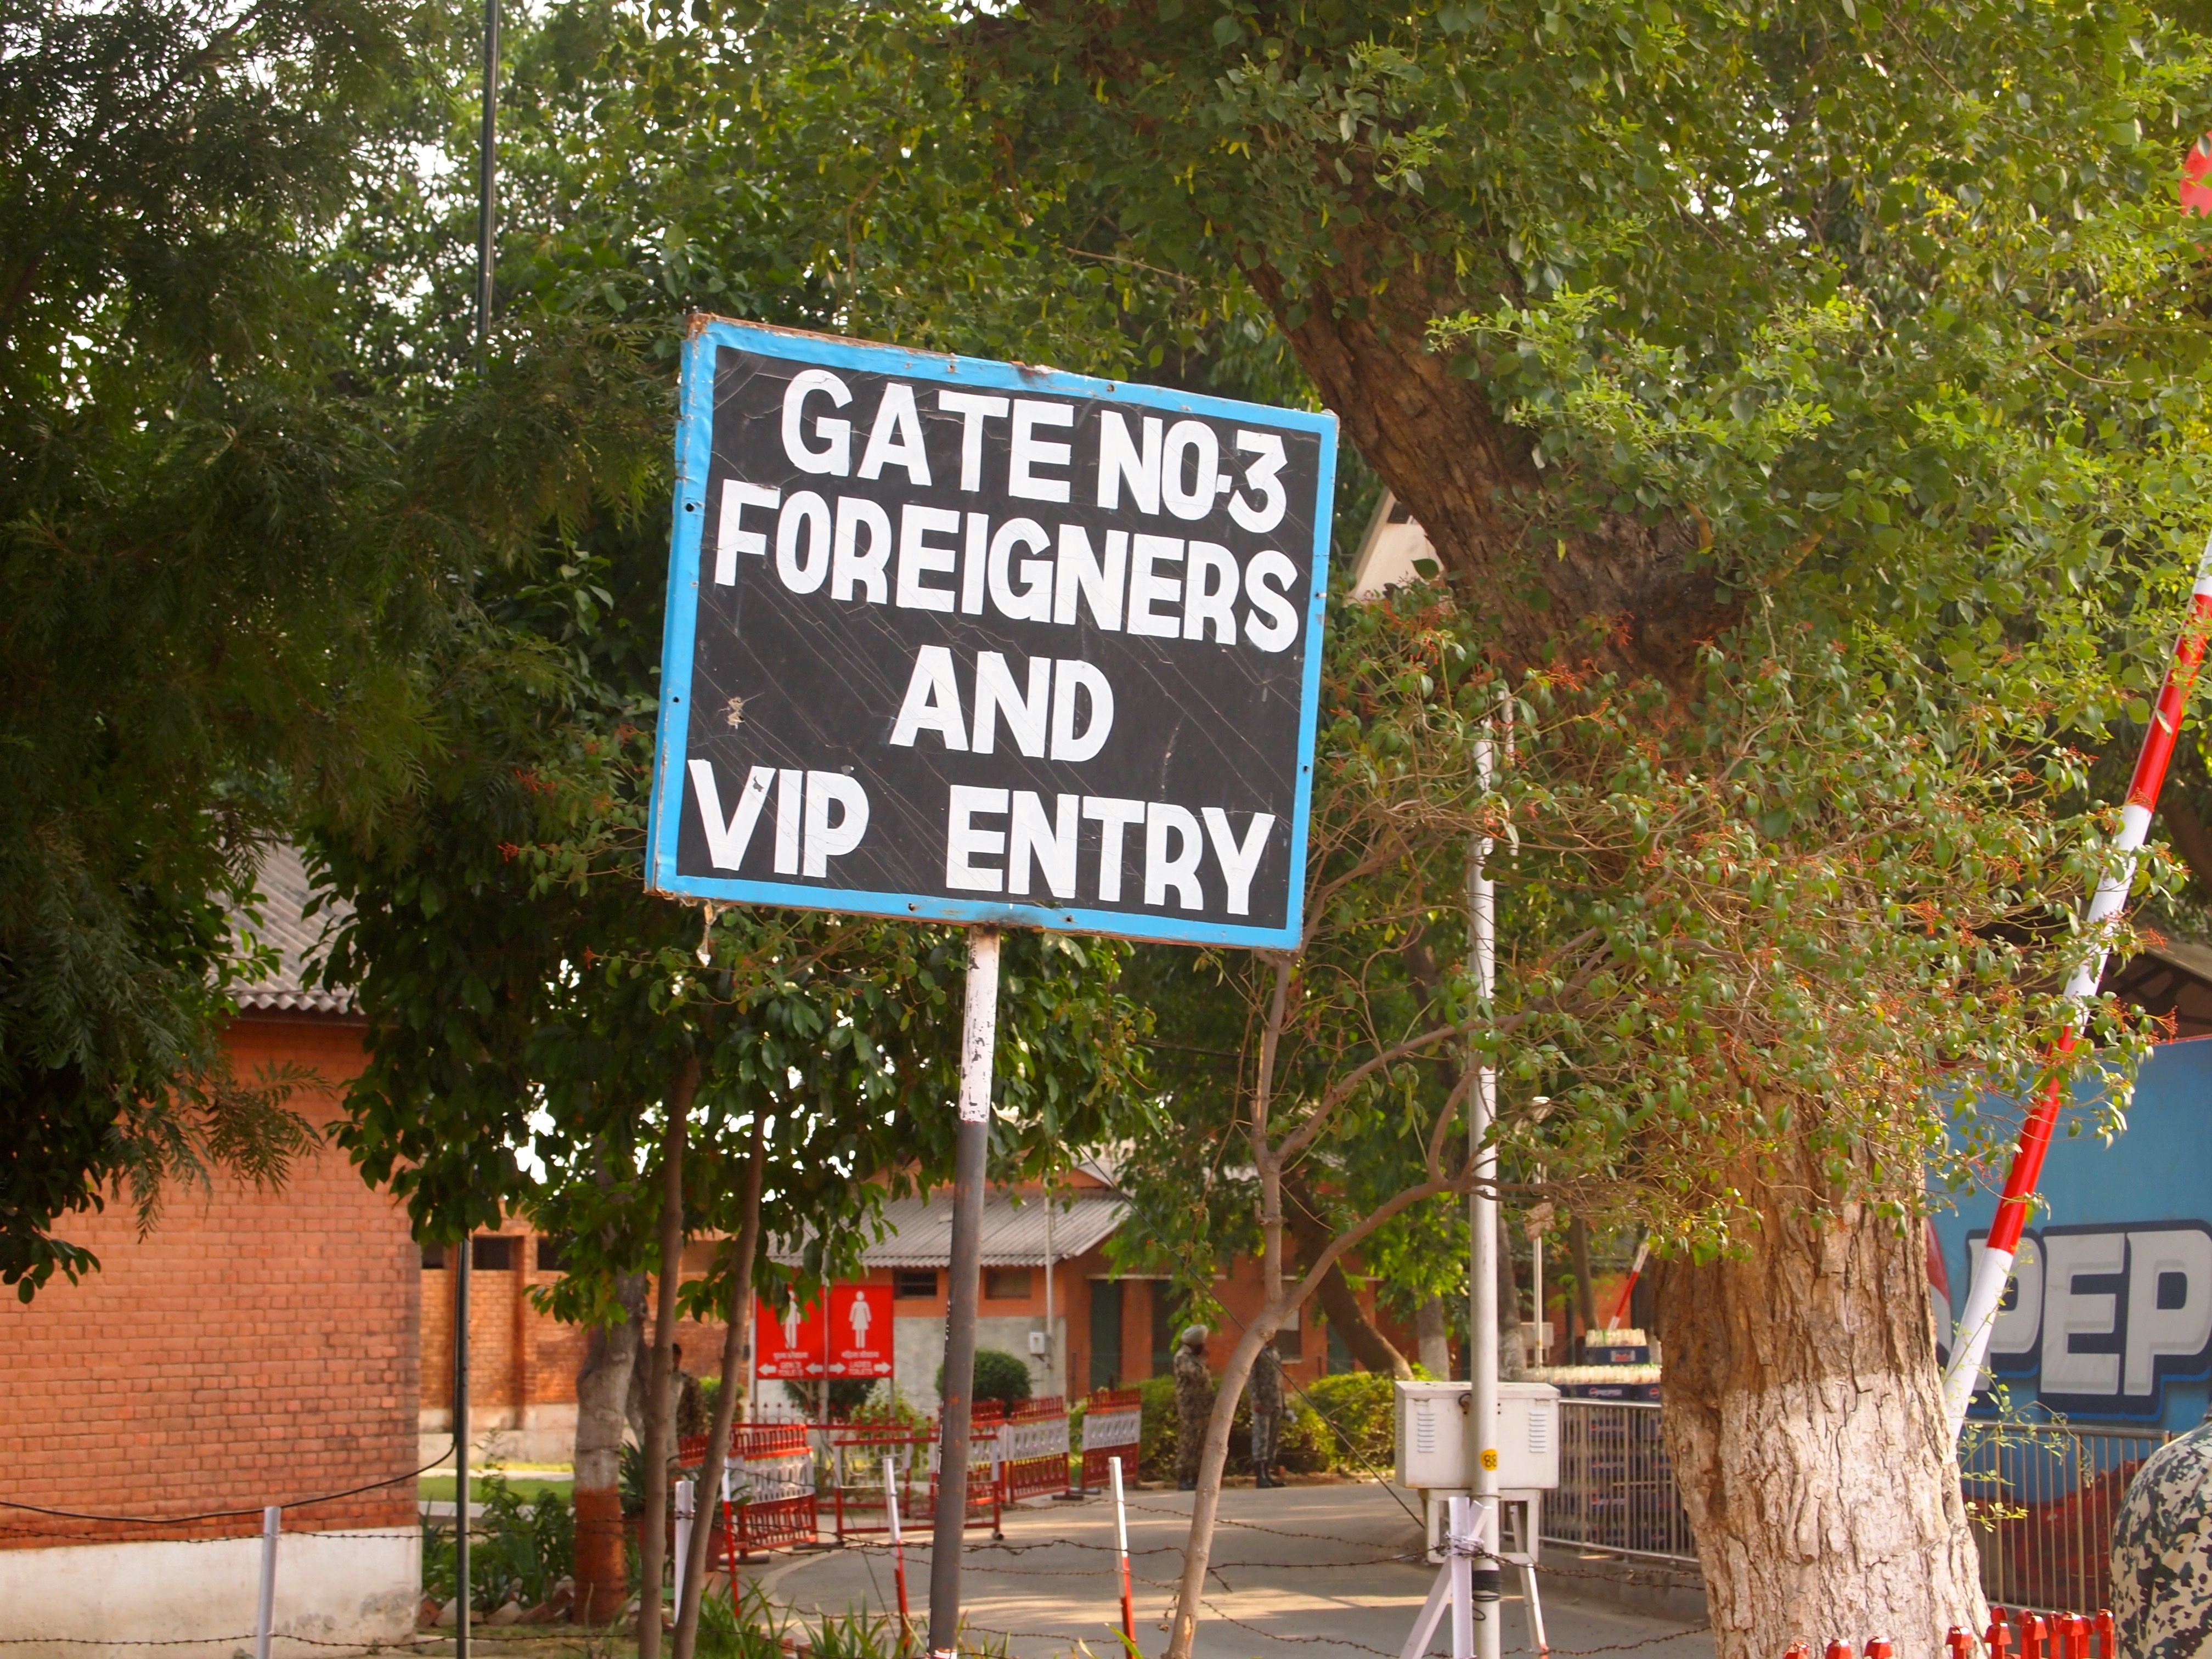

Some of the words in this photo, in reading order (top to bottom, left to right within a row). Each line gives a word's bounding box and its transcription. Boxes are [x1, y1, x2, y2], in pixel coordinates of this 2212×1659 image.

[781, 369, 1075, 504] GATE
[714, 479, 1299, 653] FOREIGNERS
[889, 645, 1114, 762] AND
[688, 759, 870, 878] VIP
[946, 785, 1276, 916] ENTRY
